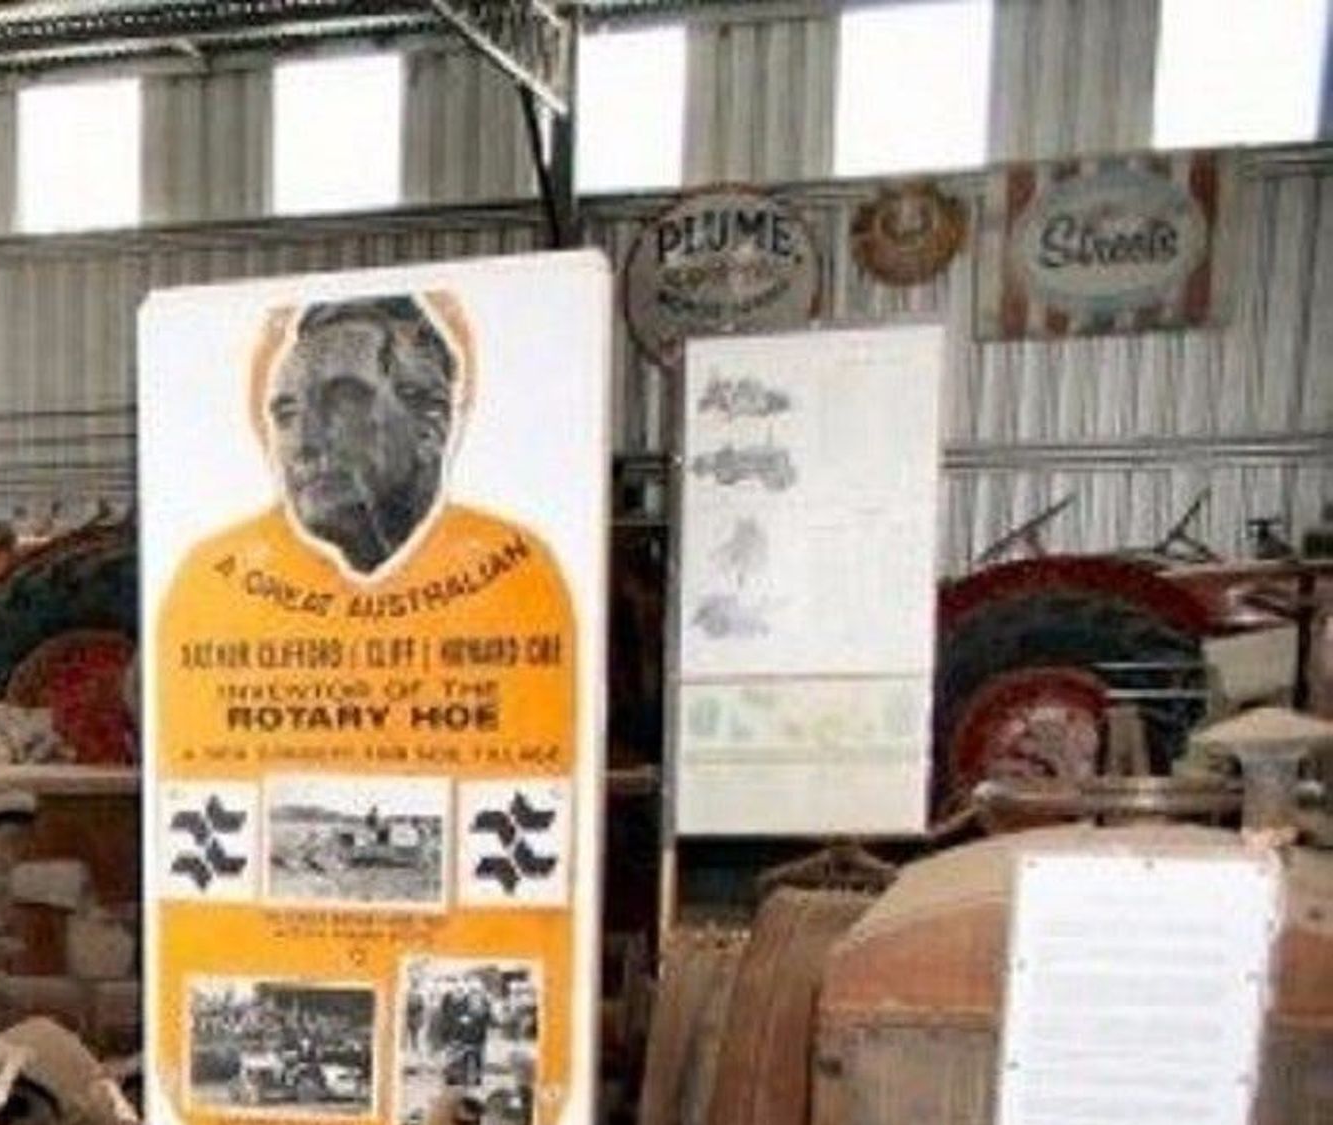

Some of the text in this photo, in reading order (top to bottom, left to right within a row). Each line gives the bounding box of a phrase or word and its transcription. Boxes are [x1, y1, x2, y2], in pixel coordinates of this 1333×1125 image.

[246, 569, 336, 618] GREAT
[346, 536, 532, 620] AUSTRALIAN
[218, 679, 499, 702] INVENTOR OF THE
[226, 704, 499, 732] ROTARY HOE
